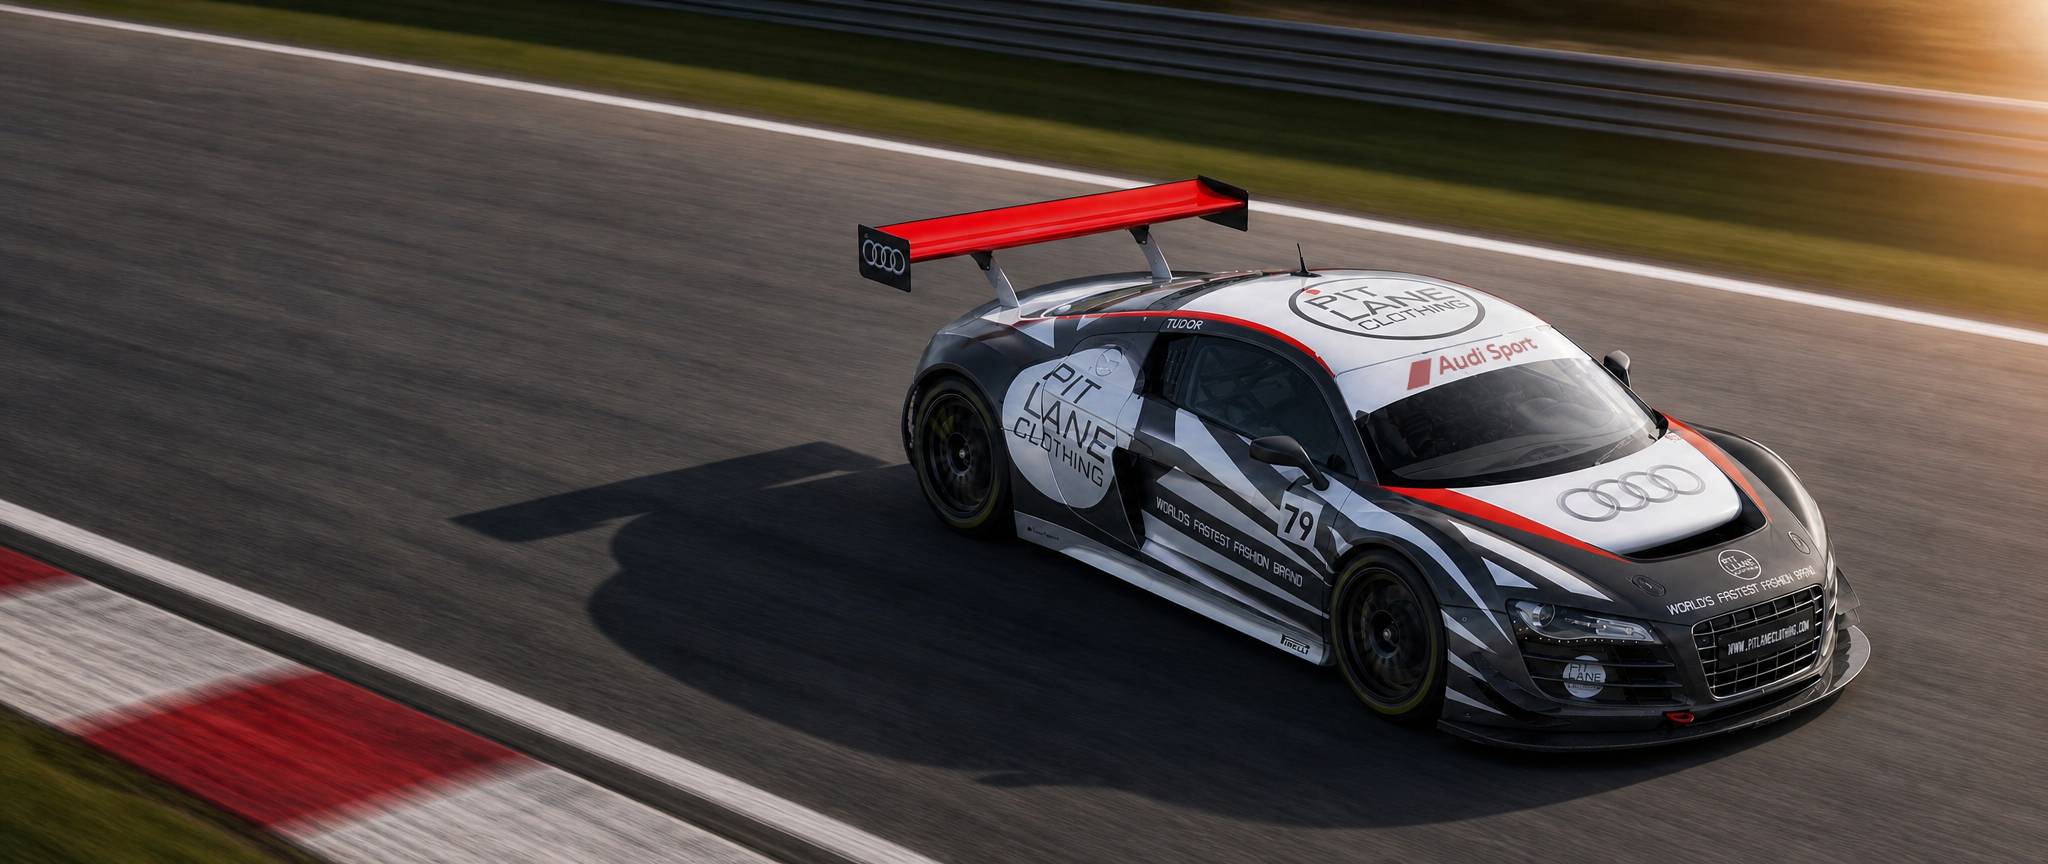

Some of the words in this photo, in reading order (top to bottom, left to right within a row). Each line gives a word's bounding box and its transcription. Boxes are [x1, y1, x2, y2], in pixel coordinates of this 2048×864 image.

[1305, 286, 1377, 310] PIT
[1330, 288, 1455, 322] LANE
[1358, 299, 1470, 331] CLOTHING
[1167, 318, 1203, 330] TUDOR
[1440, 347, 1487, 375] Audi
[1486, 336, 1538, 361] Sport
[1042, 363, 1102, 404] PIT
[1024, 381, 1116, 464] LANE
[1013, 416, 1104, 487] CLOTHING
[1284, 503, 1314, 541] 79
[1156, 496, 1191, 527] WORLDS
[1193, 519, 1231, 549] FASTEST
[1233, 541, 1270, 570] FASHION
[1273, 562, 1303, 588] BRAND
[1667, 595, 1715, 616] WORLD'S
[1717, 583, 1760, 603] FASTEST
[1760, 575, 1794, 592] FASHION
[1569, 672, 1602, 682] LANE
